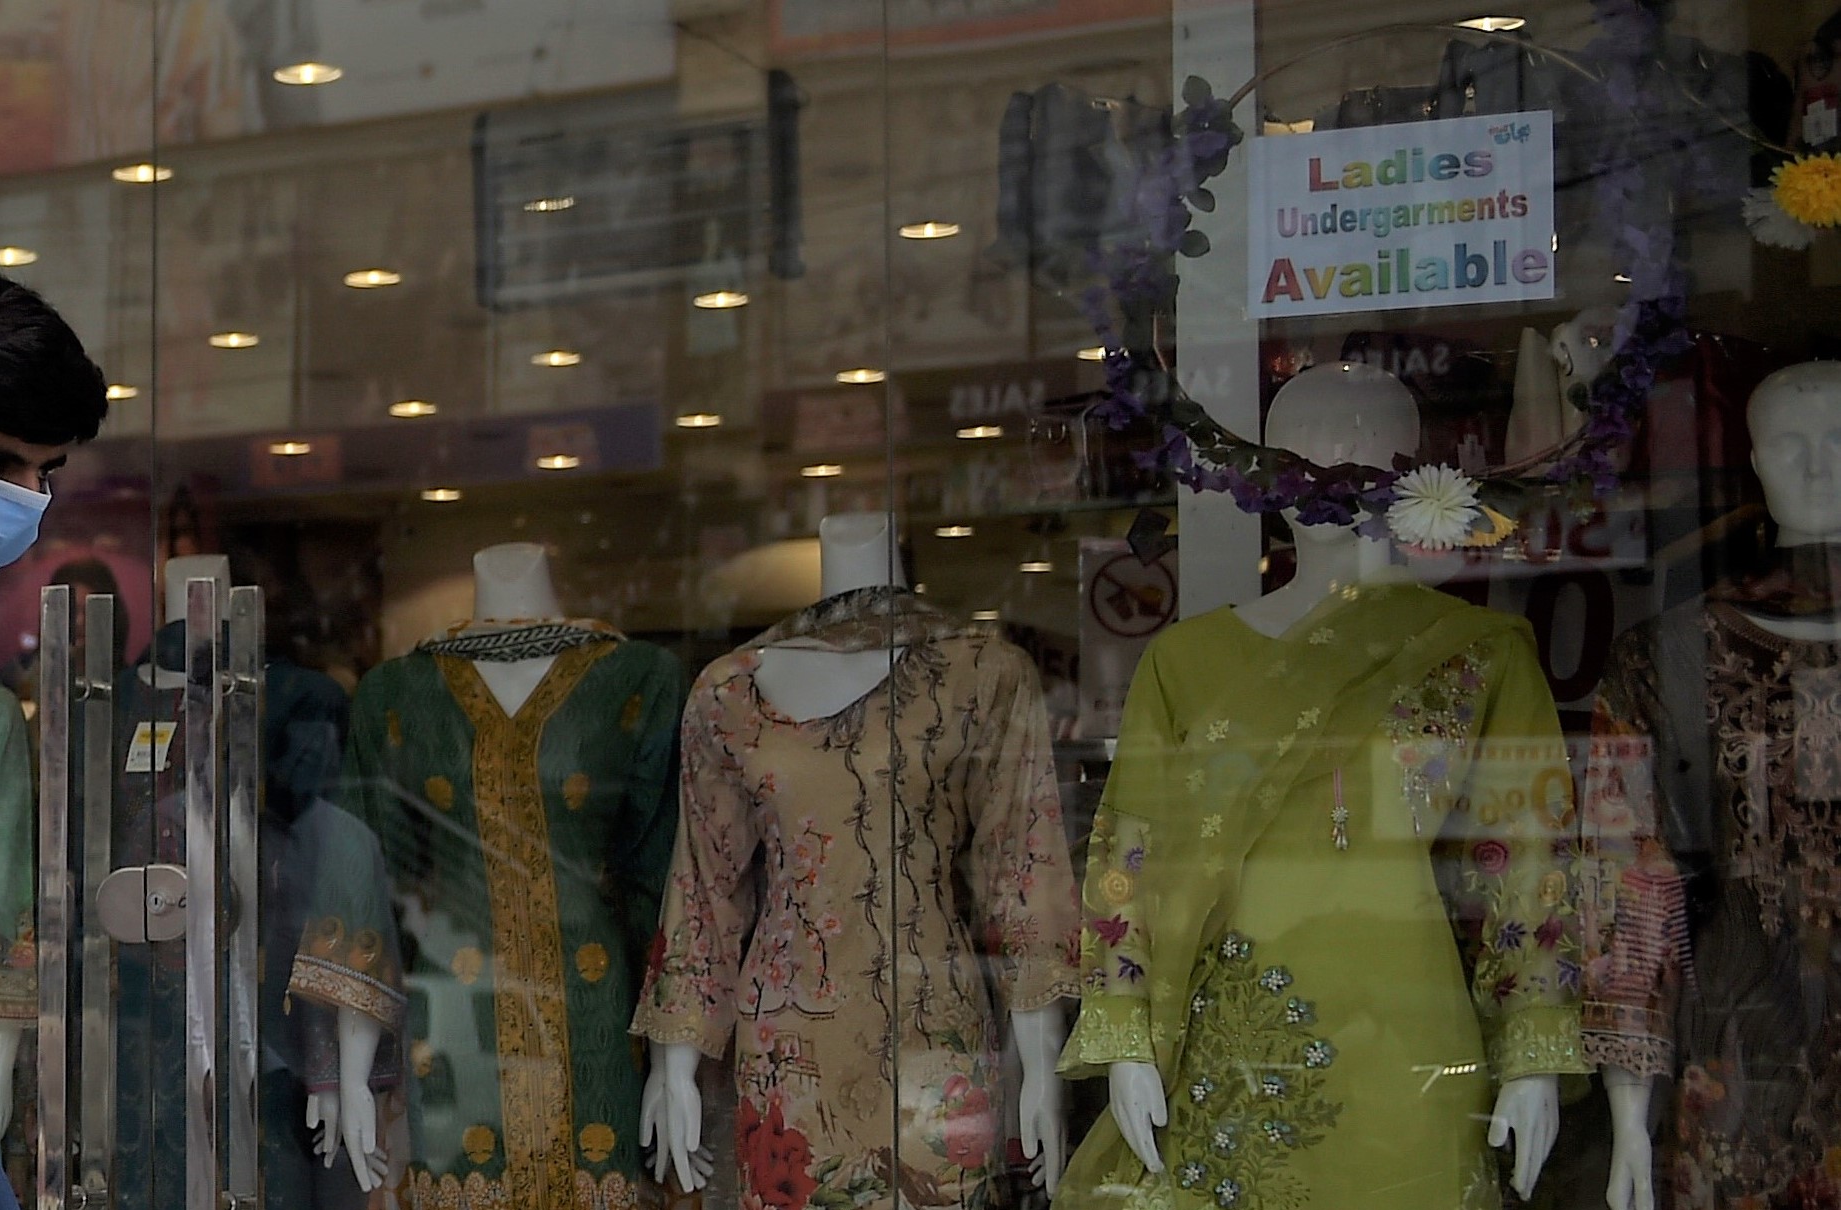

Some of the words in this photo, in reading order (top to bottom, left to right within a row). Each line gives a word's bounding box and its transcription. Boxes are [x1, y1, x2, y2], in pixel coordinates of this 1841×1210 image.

[1308, 148, 1494, 192] Ladies
[1276, 189, 1529, 238] Undergarments
[1261, 239, 1549, 304] Available
